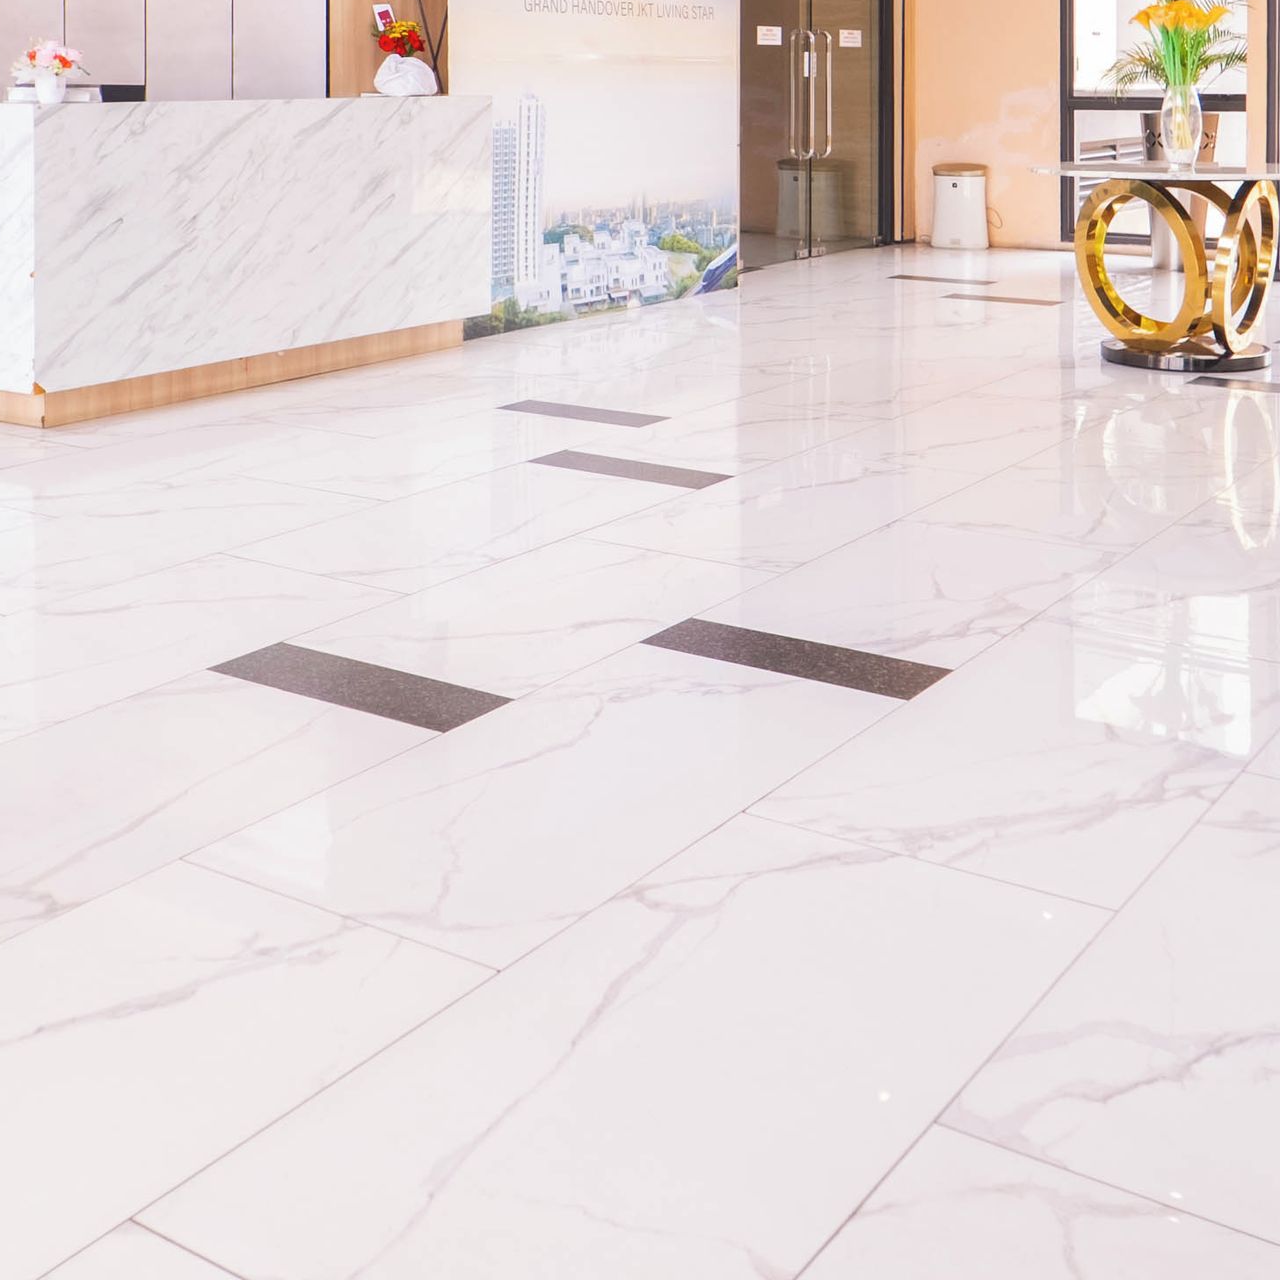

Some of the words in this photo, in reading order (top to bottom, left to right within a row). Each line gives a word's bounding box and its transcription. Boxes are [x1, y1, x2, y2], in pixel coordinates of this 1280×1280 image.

[571, 0, 634, 17] HANDOVER
[636, 2, 654, 17] JKT
[656, 4, 689, 19] LIVING
[691, 6, 715, 20] STAR
